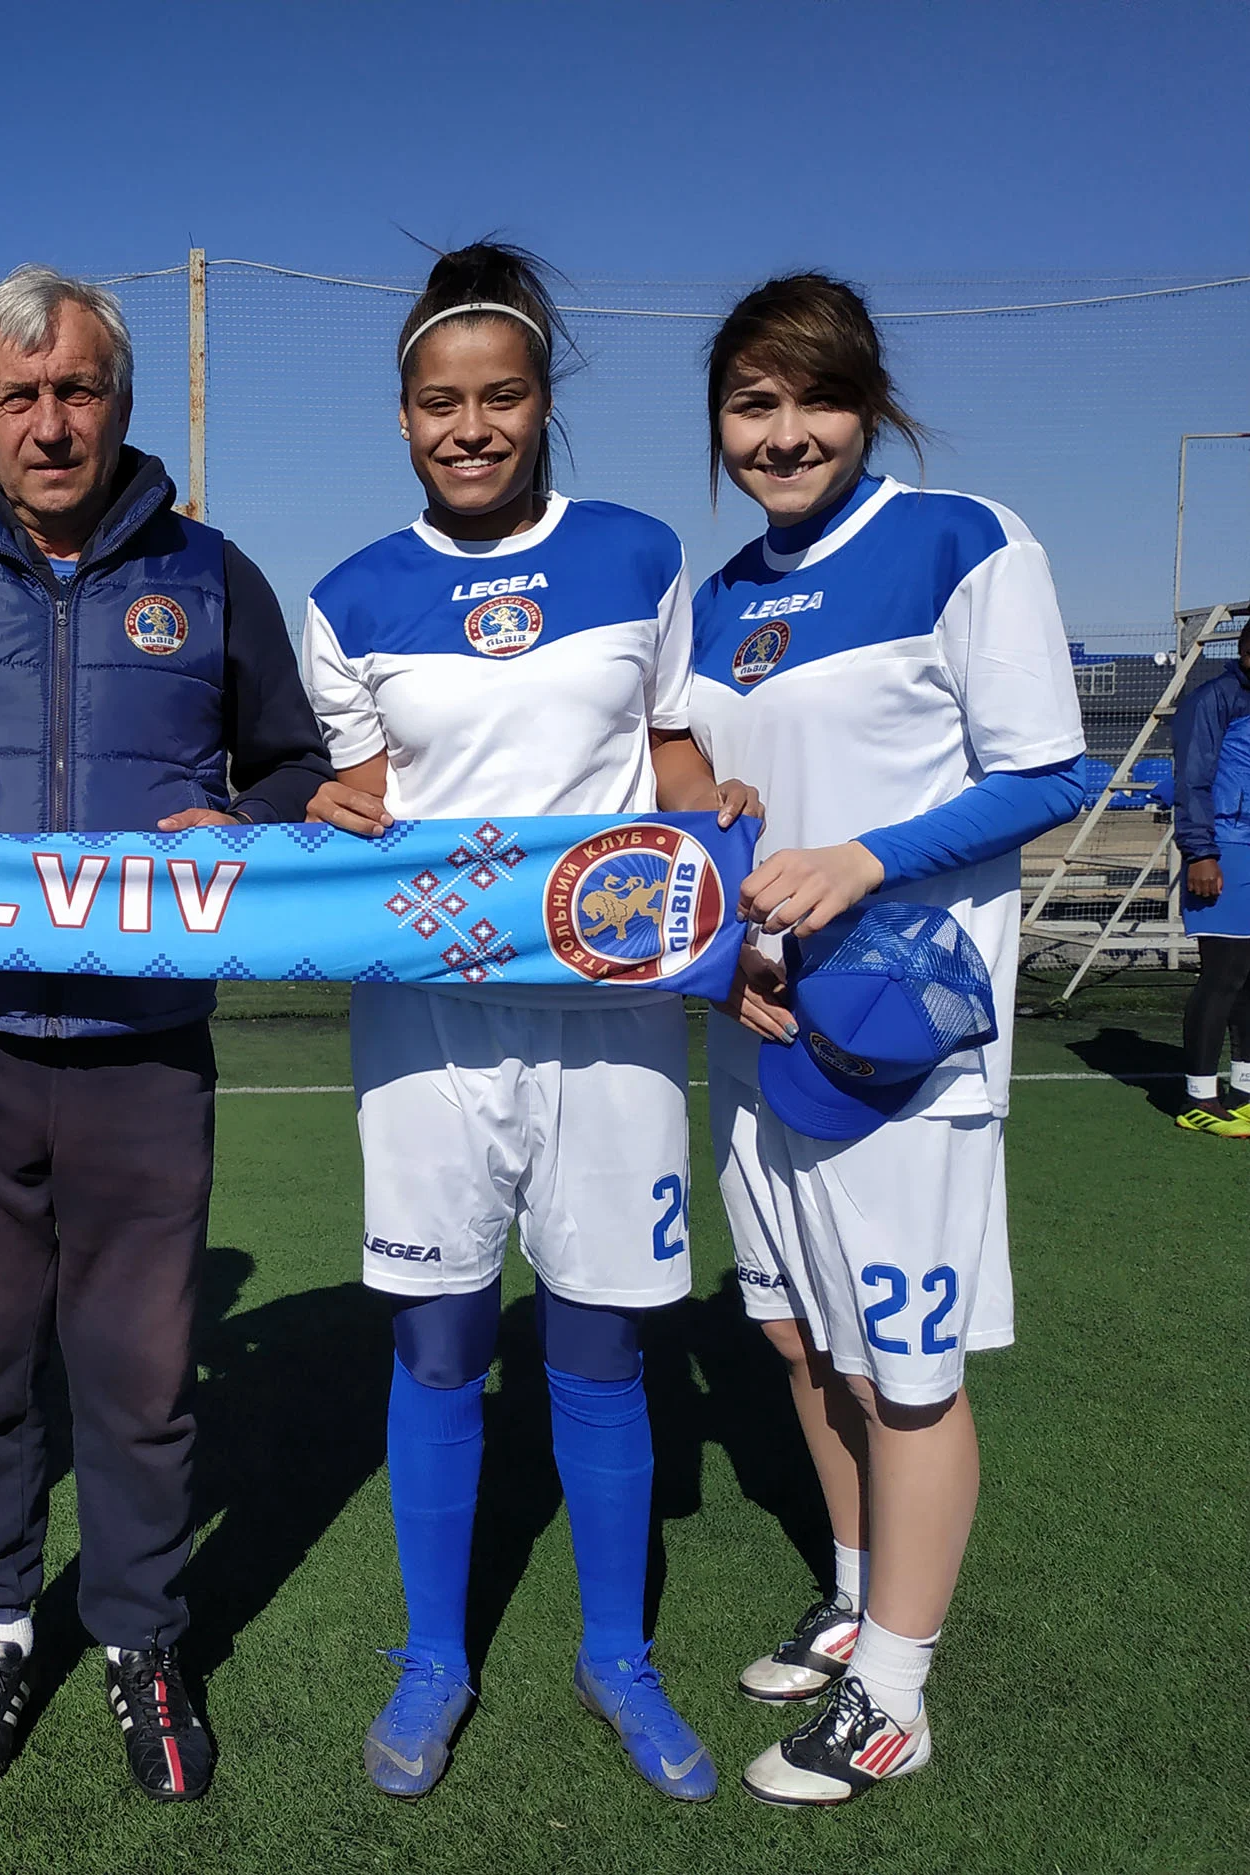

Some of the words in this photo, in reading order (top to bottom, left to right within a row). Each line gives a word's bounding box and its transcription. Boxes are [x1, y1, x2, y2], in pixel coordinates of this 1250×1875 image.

[452, 572, 549, 601] LEGEA
[739, 591, 824, 619] LEGEA
[581, 831, 643, 860] КЛУБ
[553, 862, 610, 975] УТБОЛЬНИЙ
[668, 863, 696, 952] ЛЬВІВ
[652, 1171, 689, 1261] 2
[363, 1231, 442, 1263] LEGEA
[738, 1265, 791, 1289] EGEA
[861, 1261, 960, 1356] 22
